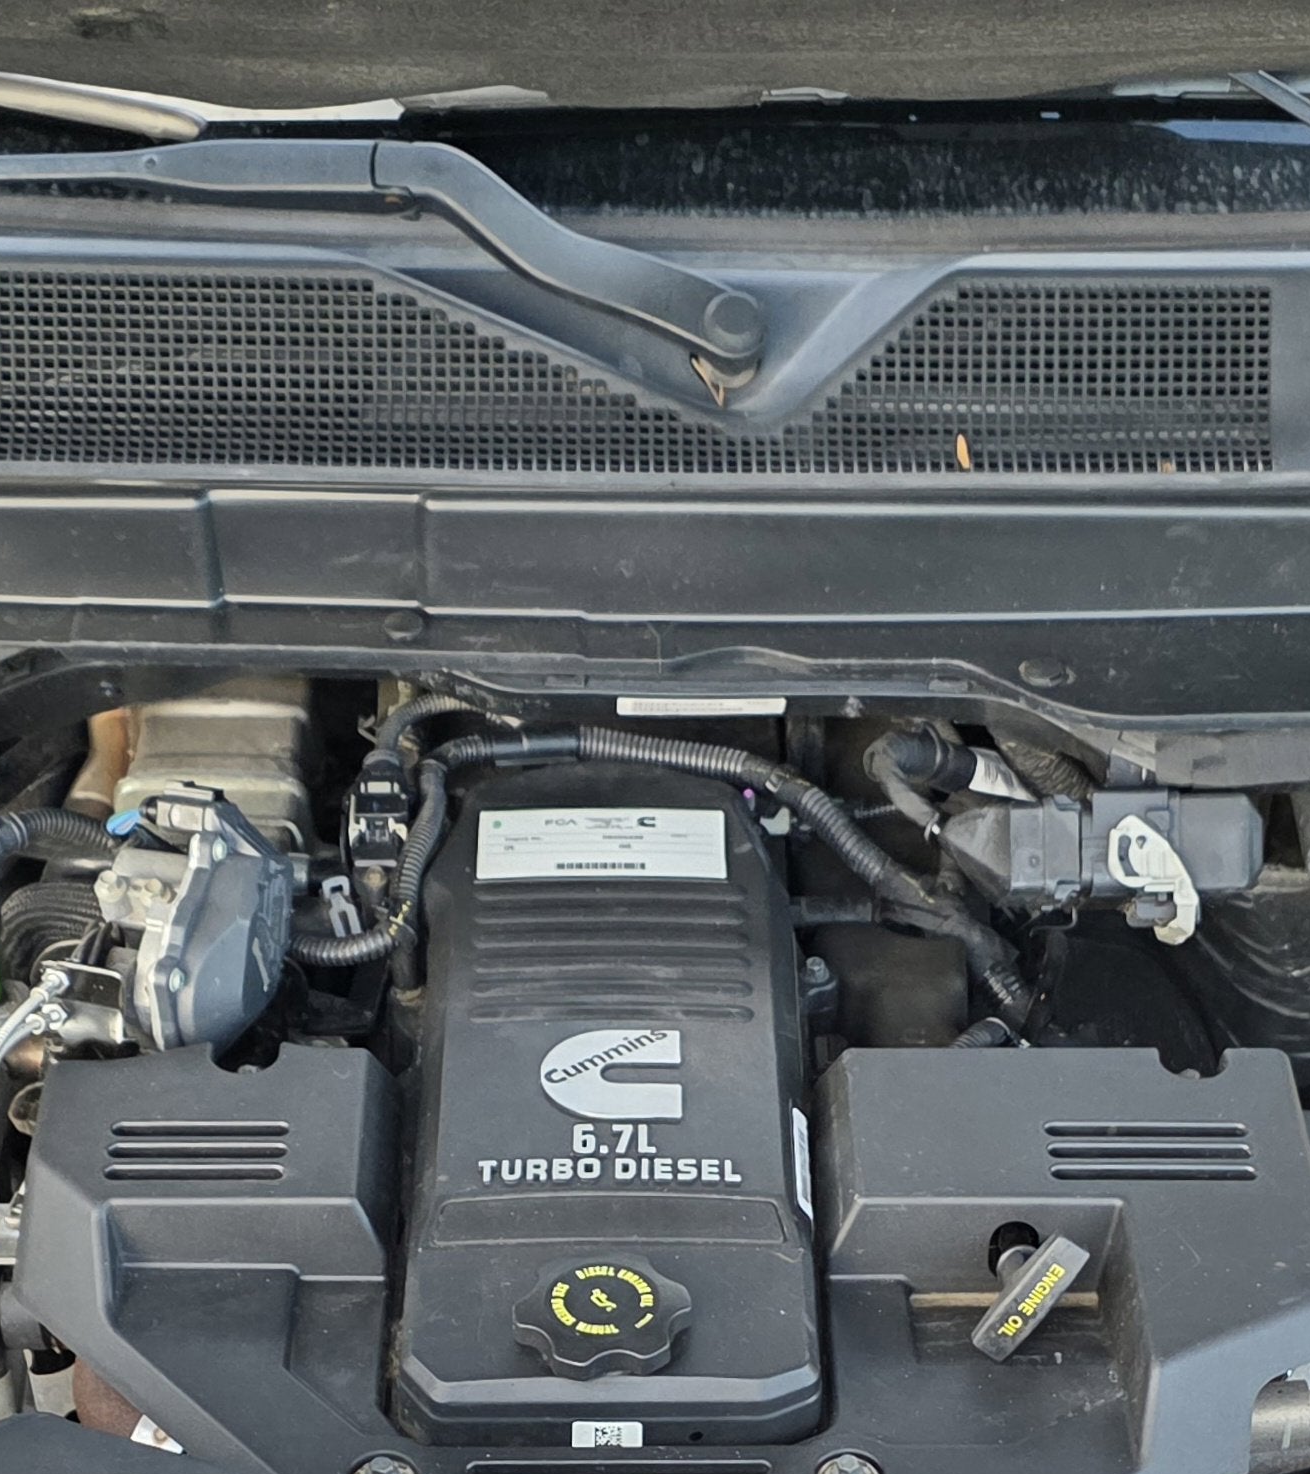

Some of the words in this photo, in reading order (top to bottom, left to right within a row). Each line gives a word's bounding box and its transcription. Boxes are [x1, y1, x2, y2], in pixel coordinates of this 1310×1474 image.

[543, 1029, 669, 1084] Cummins
[572, 1123, 657, 1155] 6.7L
[478, 1157, 601, 1184] TURBO
[614, 1157, 743, 1184] DIESEL
[1017, 1263, 1066, 1317] ENGINE
[997, 1315, 1024, 1337] OIL
